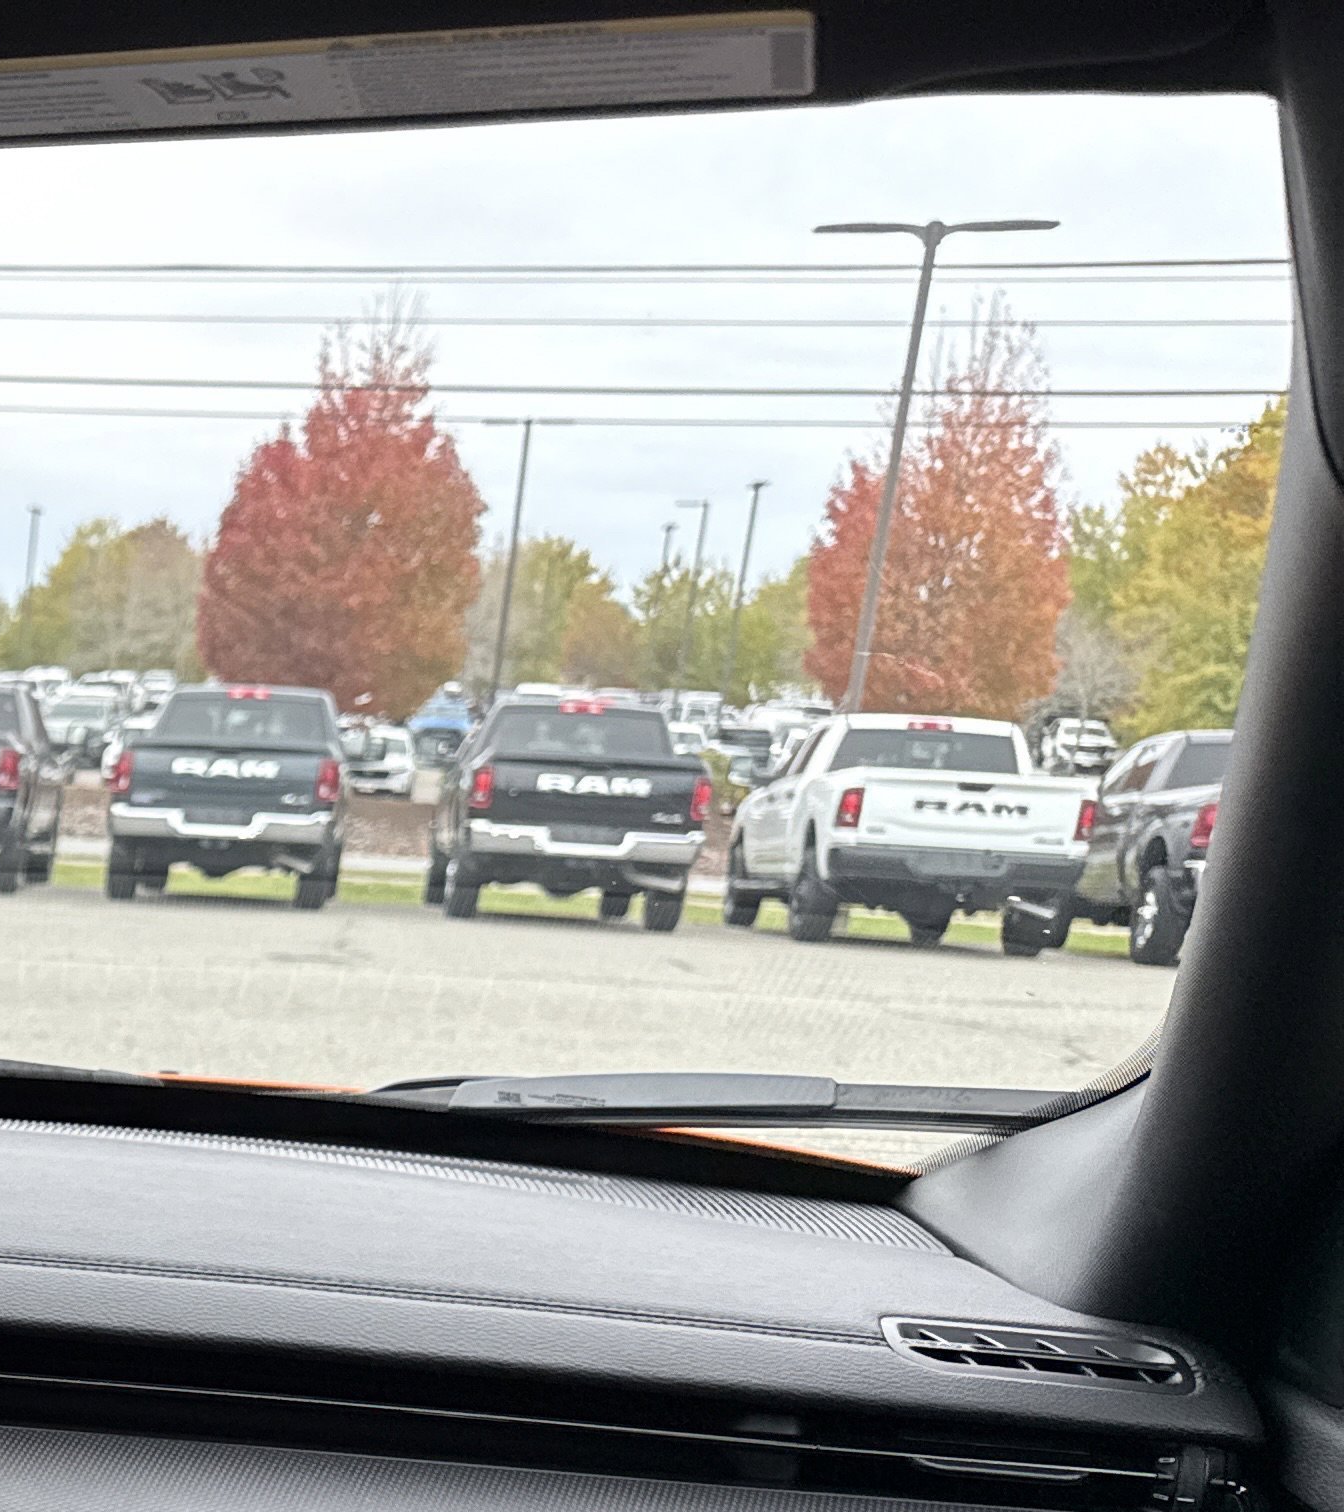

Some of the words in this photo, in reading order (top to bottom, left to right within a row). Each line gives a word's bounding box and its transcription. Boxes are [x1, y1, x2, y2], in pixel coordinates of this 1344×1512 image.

[171, 757, 280, 779] RAM
[536, 774, 652, 797] RAM
[914, 799, 1029, 816] RAM
